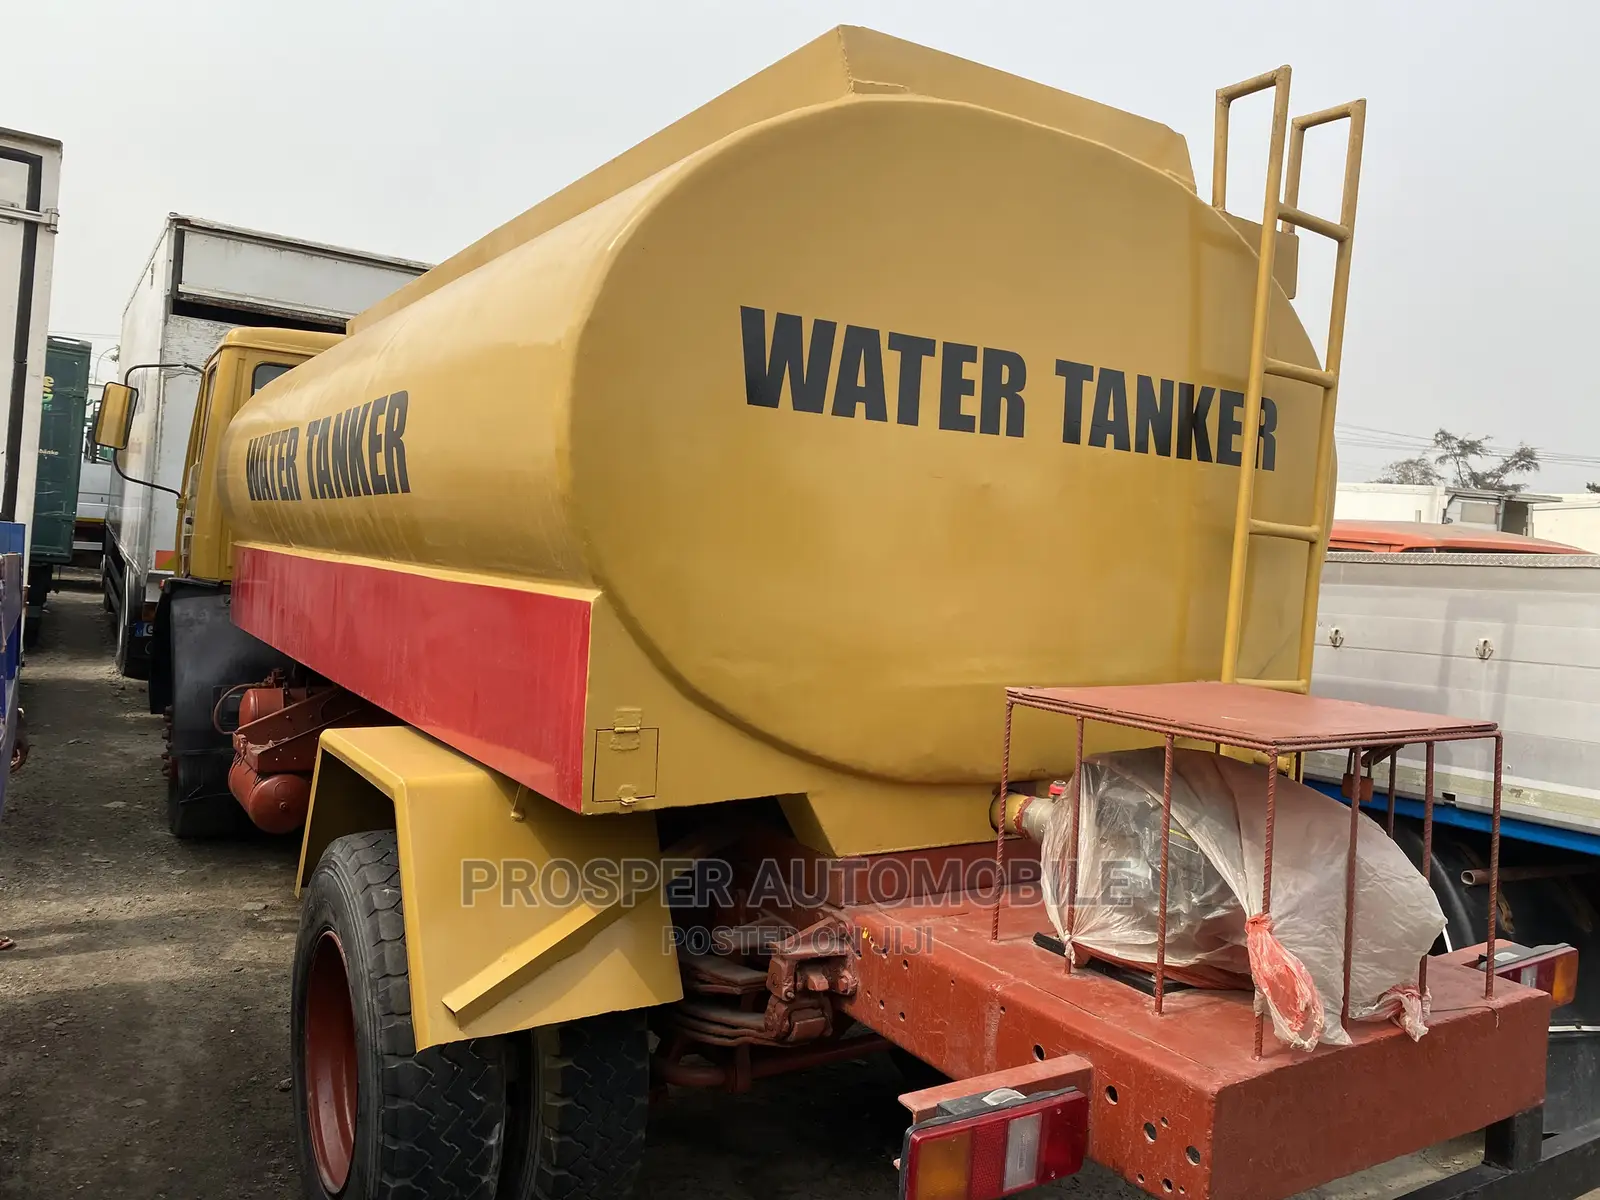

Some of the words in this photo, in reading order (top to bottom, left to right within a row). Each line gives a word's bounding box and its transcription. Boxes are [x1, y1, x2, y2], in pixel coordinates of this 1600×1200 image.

[246, 426, 302, 501] WATER
[306, 390, 411, 500] TANKER
[740, 305, 1028, 438] WATER
[1055, 358, 1278, 471] TANKER
